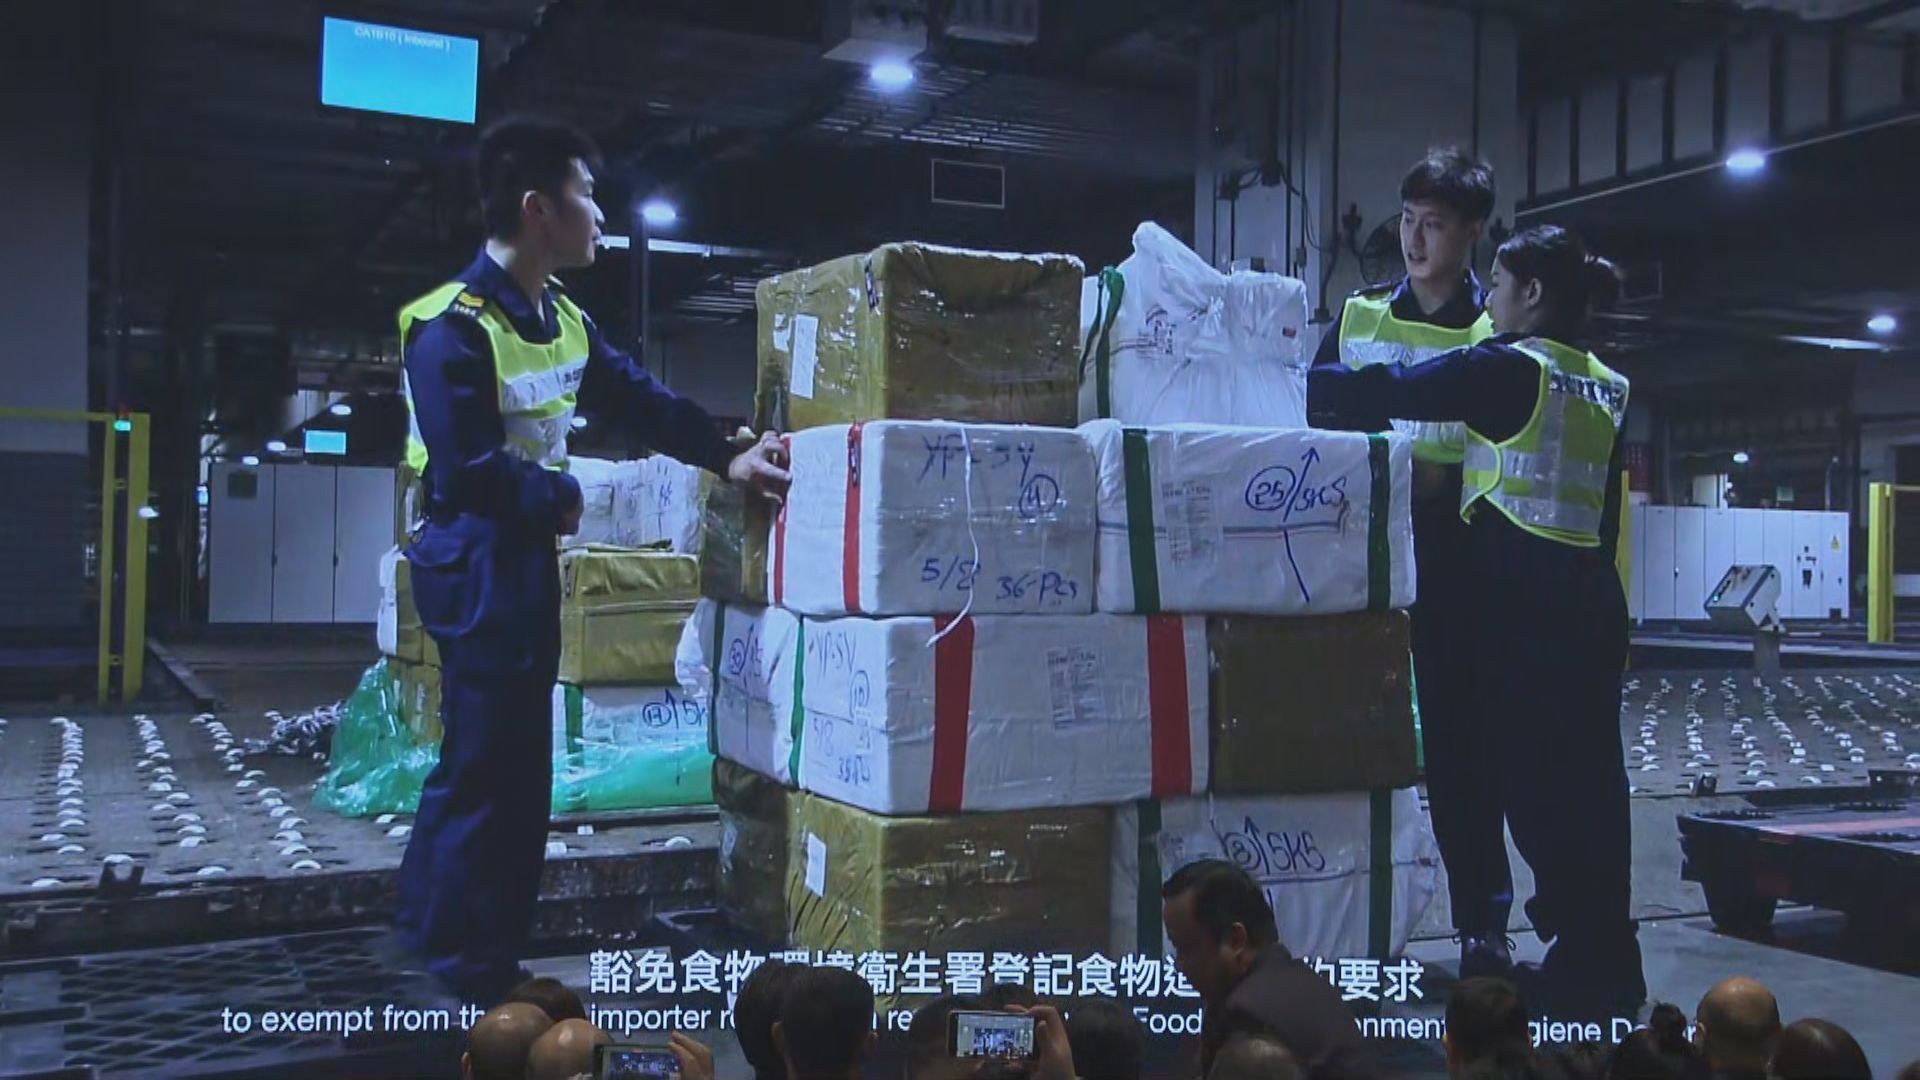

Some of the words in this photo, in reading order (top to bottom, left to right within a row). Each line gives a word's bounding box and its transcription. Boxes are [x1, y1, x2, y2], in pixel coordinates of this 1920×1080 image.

[221, 1006, 251, 1033] to
[261, 1005, 374, 1037] exempt
[382, 1004, 449, 1031] from
[458, 1004, 485, 1031] th
[590, 1003, 711, 1036] importer
